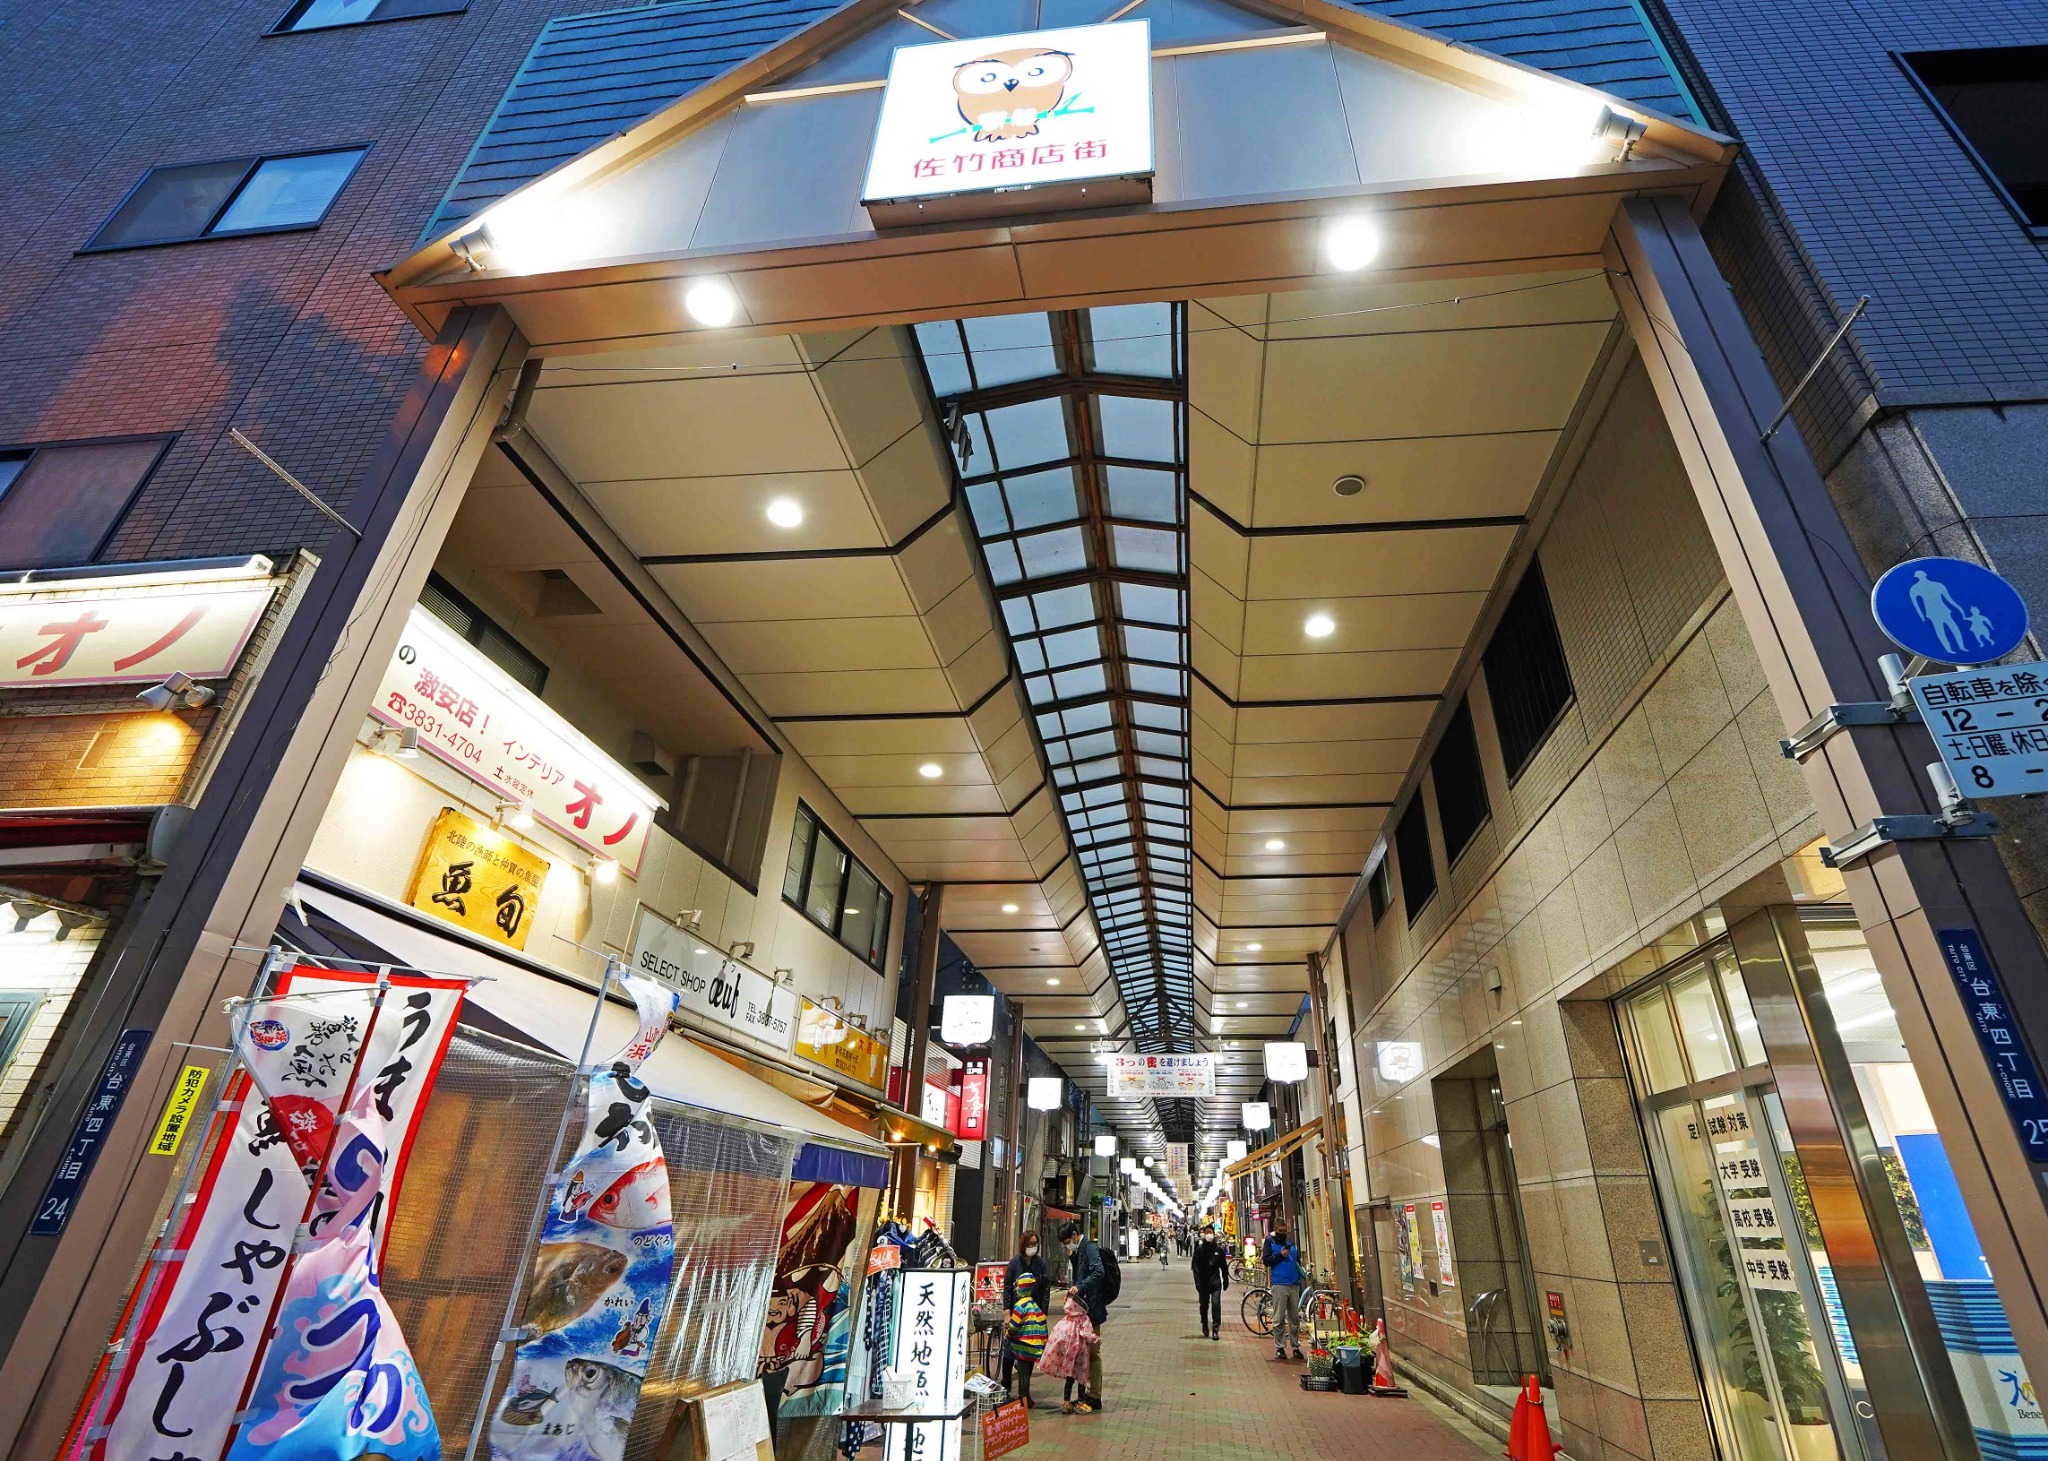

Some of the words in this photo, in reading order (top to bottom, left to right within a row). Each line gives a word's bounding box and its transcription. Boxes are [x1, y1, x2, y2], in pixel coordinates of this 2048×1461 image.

[913, 139, 1107, 179] 佐竹商店街
[16, 603, 210, 676] オノ
[413, 666, 490, 735] 激安店！
[1941, 708, 1978, 732] 12
[404, 703, 482, 763] 3831-4704
[1971, 764, 1995, 789] 8
[503, 740, 565, 785] インテリア
[565, 779, 639, 845] オノ
[1947, 944, 1960, 964] TAITO
[1956, 965, 1968, 983] CITY
[1959, 943, 1977, 971] 台東区
[640, 951, 679, 982] SELECT
[681, 970, 706, 994] SHOP
[744, 1012, 756, 1025] FAX
[748, 1001, 757, 1014] TEL
[1975, 1012, 1989, 1034] TAITO
[1970, 977, 2034, 1099] 台東四丁目
[112, 1042, 126, 1066] TAITO
[106, 1066, 117, 1078] CITY
[1995, 1063, 2016, 1099] 4-CHOME
[84, 1102, 97, 1122] TAITO
[156, 1068, 204, 1153] 防犯カメラ設置地域
[64, 1072, 125, 1181] 台東四丁目
[57, 1147, 76, 1180] 4-CHOME
[1720, 1158, 1762, 1179] 大学受験
[40, 1197, 70, 1221] 24
[1732, 1207, 1776, 1228] 高校受験
[633, 1235, 671, 1248] のどぐろ
[1746, 1258, 1792, 1281] 中学受験
[604, 1296, 634, 1308] かれい
[2017, 1408, 2043, 1420] Bene
[543, 1420, 576, 1436] まあじ
